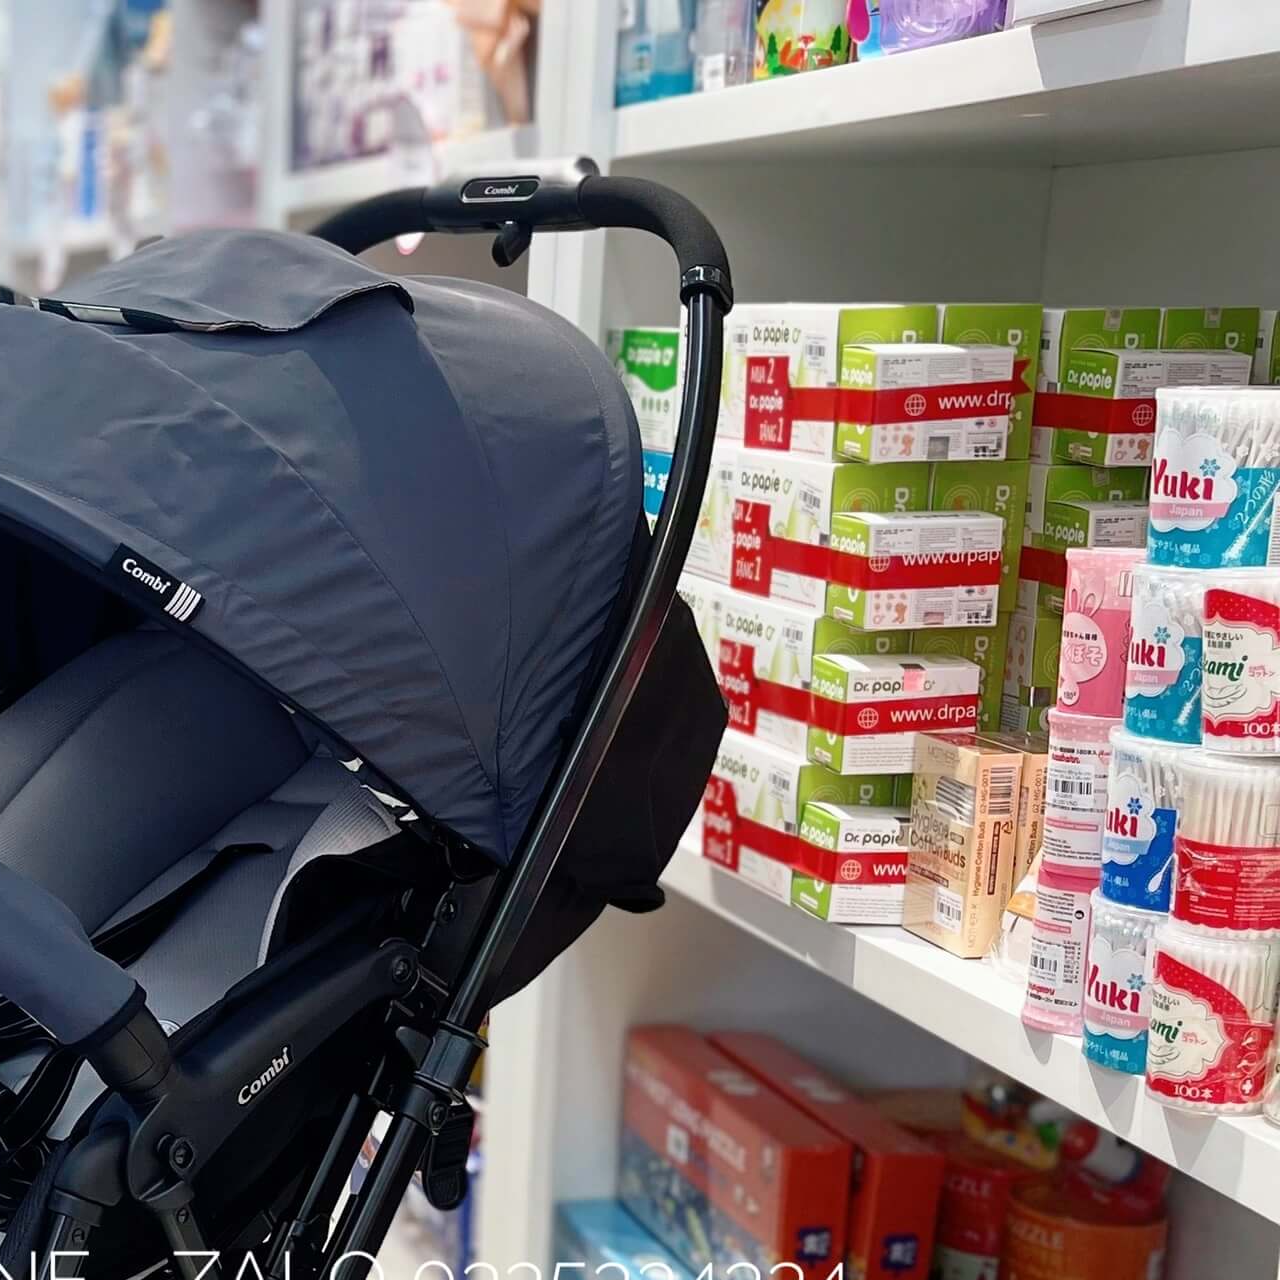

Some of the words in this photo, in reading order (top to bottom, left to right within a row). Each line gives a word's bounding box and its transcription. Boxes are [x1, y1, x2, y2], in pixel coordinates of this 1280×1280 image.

[1152, 458, 1214, 500] Yuki
[122, 558, 171, 594] Combi
[1130, 638, 1166, 669] uki
[871, 675, 904, 695] papi
[238, 1046, 289, 1105] Combi
